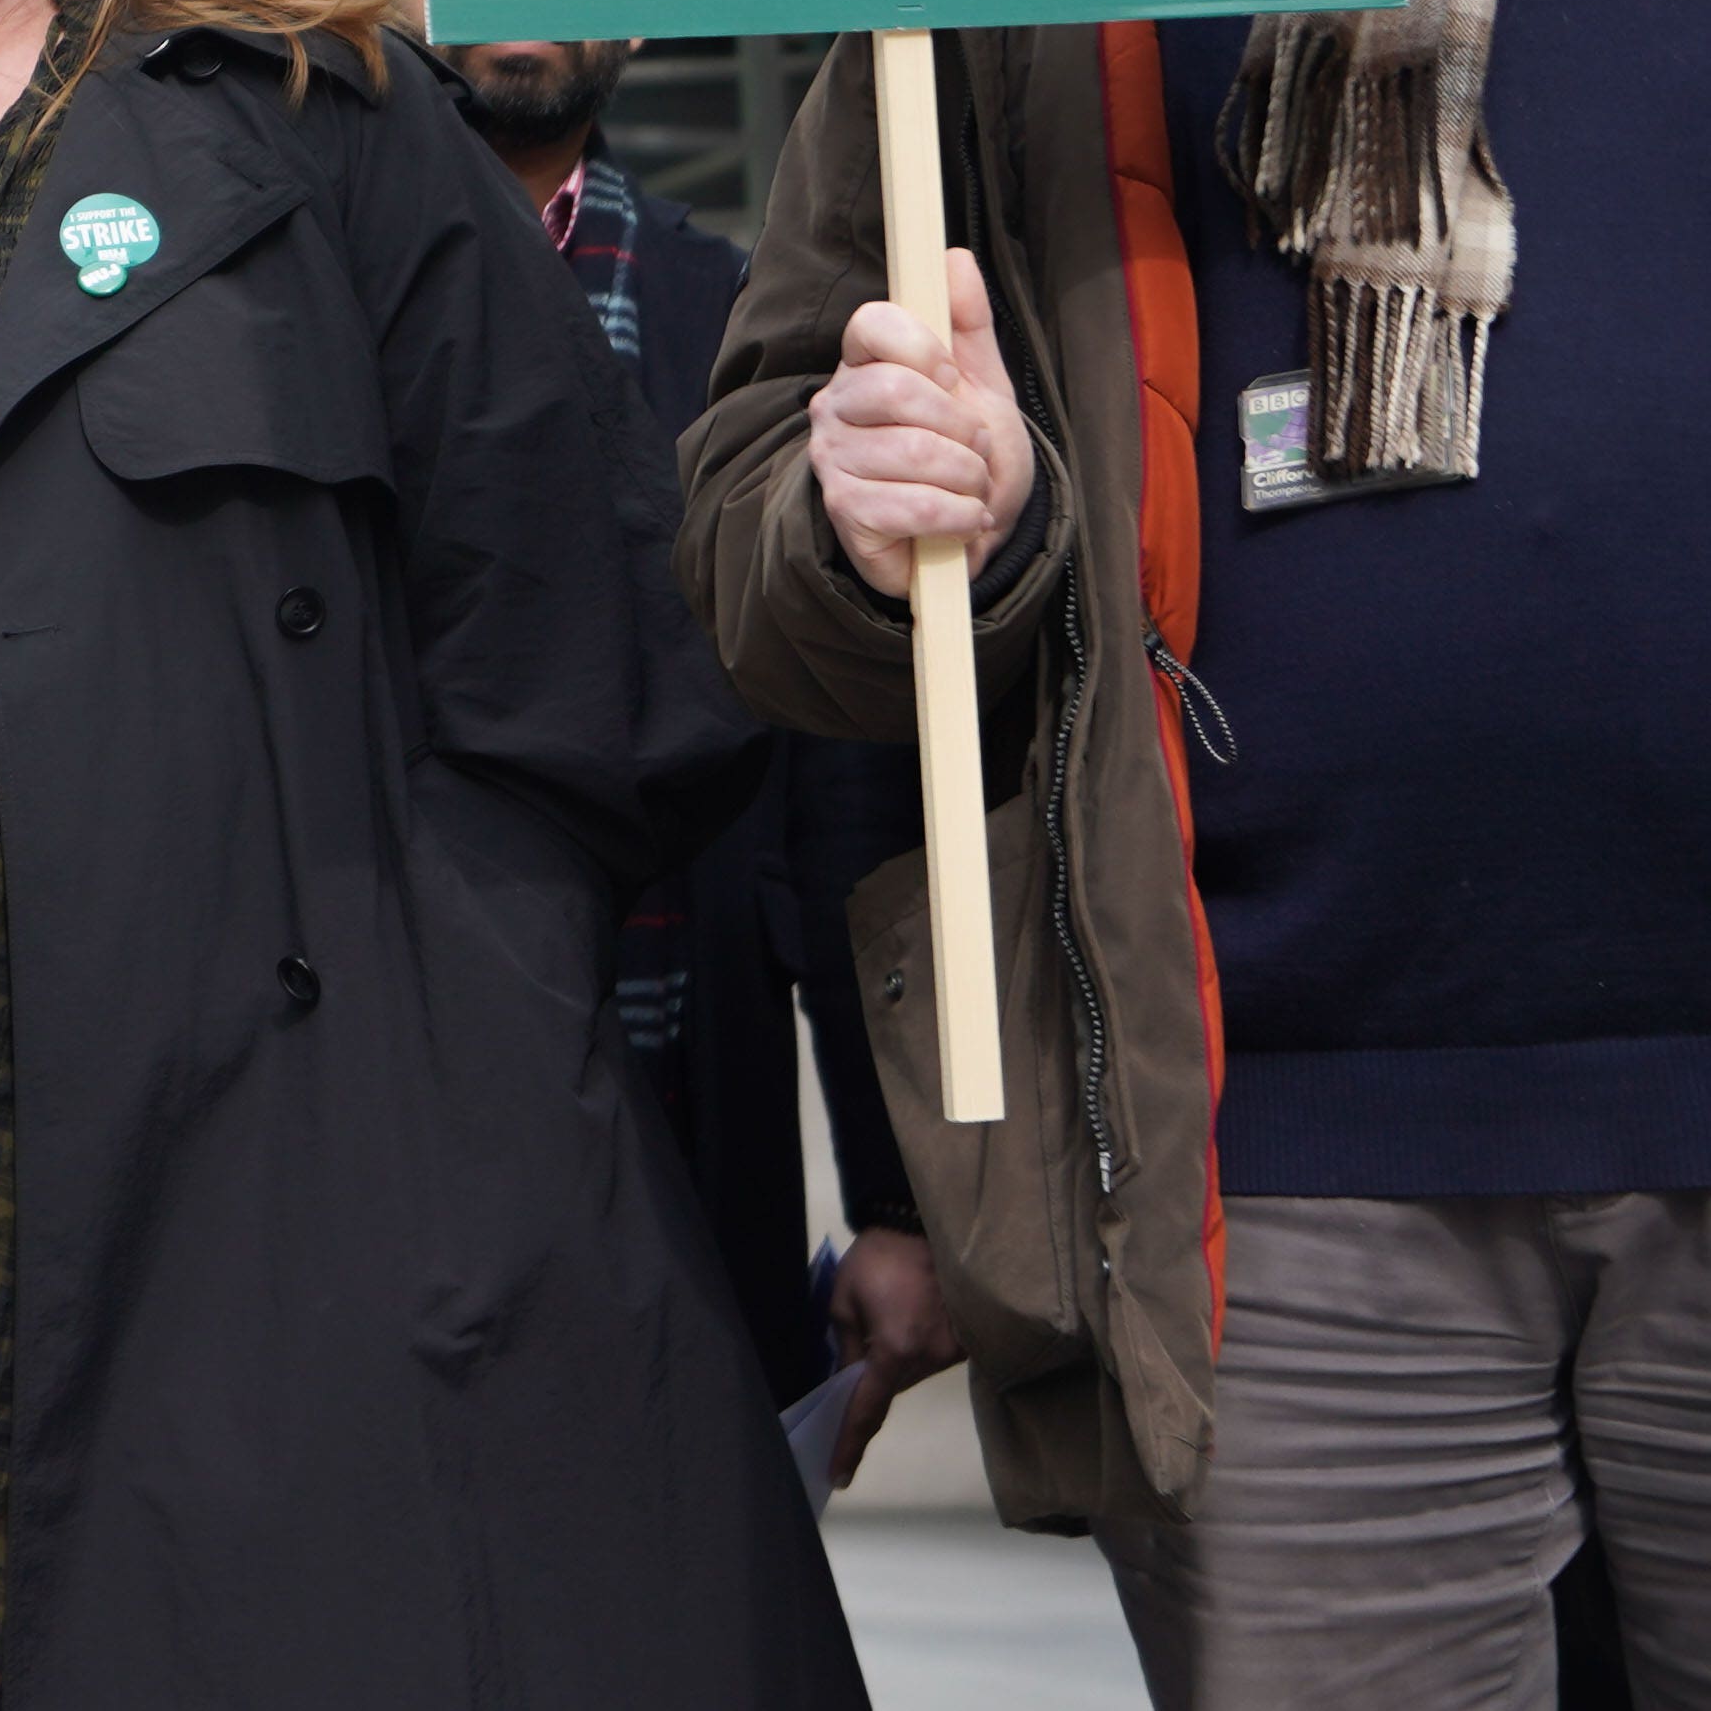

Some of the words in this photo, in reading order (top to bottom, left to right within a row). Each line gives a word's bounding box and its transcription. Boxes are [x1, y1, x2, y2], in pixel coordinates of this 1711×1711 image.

[76, 208, 116, 222] SUPPORT
[63, 218, 153, 250] STRIKE
[1251, 389, 1309, 413] BBC
